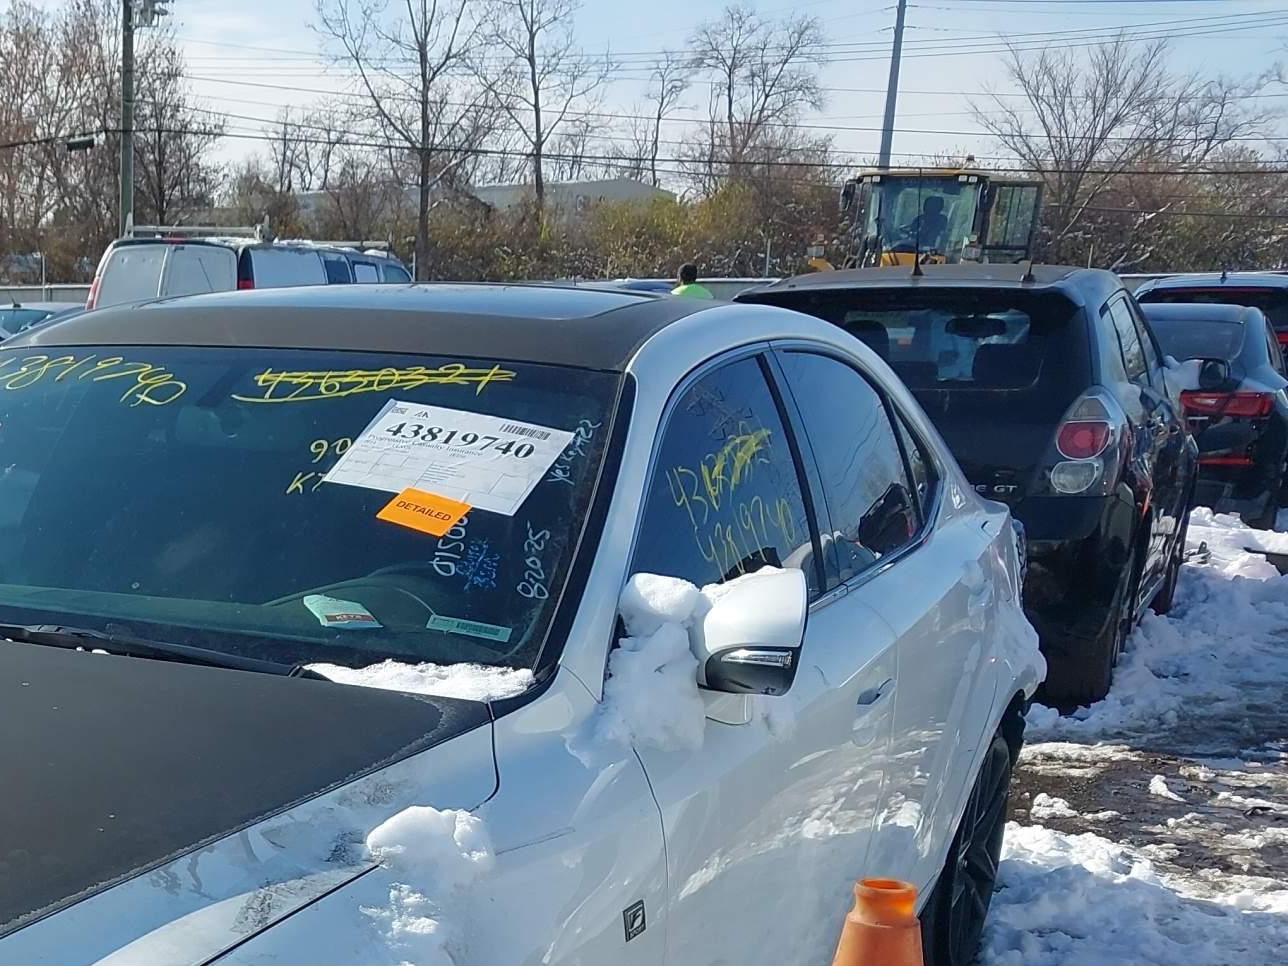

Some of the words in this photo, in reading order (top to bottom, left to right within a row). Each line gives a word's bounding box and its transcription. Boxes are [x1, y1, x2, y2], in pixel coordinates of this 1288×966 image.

[385, 420, 536, 459] 43819740
[993, 484, 1018, 493] GT
[395, 500, 452, 522] DETAILED
